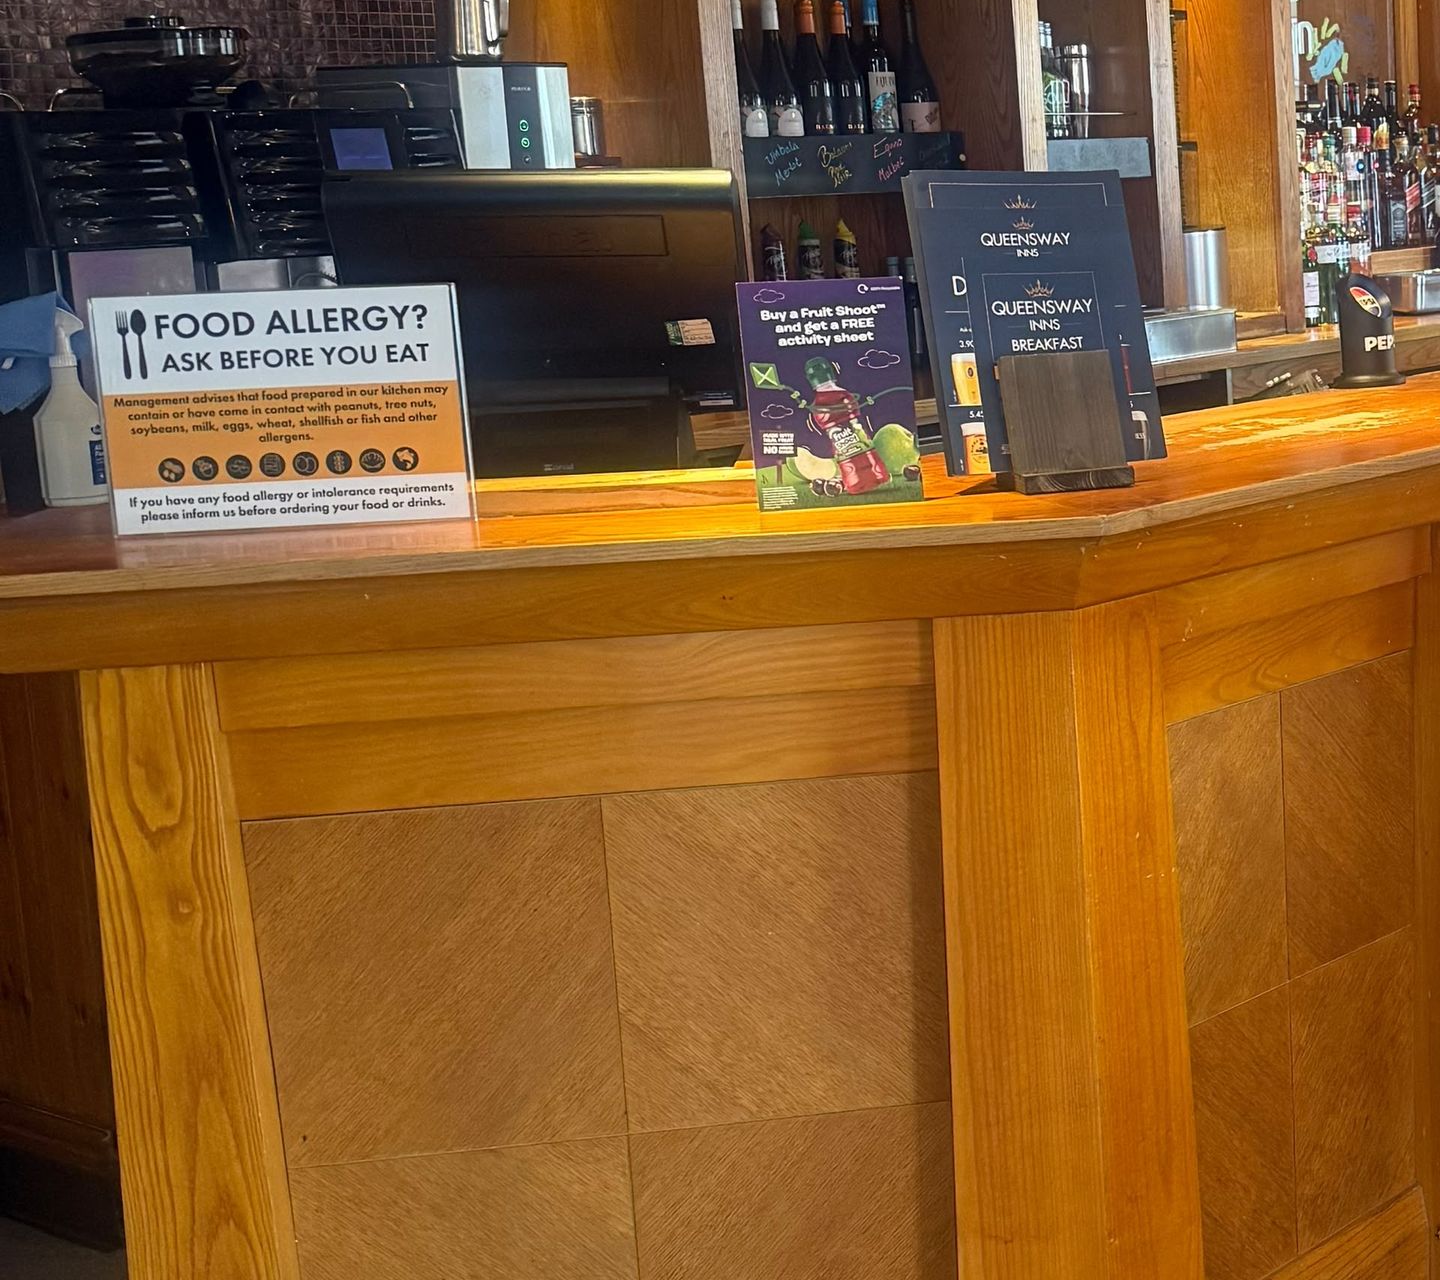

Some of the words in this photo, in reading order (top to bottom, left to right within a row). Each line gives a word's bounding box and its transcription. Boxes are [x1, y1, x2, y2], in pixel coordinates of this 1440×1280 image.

[877, 156, 905, 182] Malbec
[980, 232, 1070, 247] QUEENSWAY
[1016, 249, 1039, 258] INNS
[760, 310, 787, 322] Buy
[789, 310, 799, 319] a
[800, 307, 833, 318] Fruit
[991, 298, 1093, 317] QUEENSWAY
[154, 311, 255, 339] FOOD
[265, 304, 428, 335] ALLERGY?
[775, 322, 801, 333] and
[804, 321, 828, 335] get
[830, 321, 839, 330] a
[841, 317, 875, 329] FREE
[1029, 319, 1061, 332] INNS
[778, 334, 831, 347] activity
[833, 331, 874, 343] sheet
[1011, 336, 1083, 353] BREAKFAST
[1364, 334, 1396, 352] PEP
[162, 352, 213, 373] ASK
[220, 347, 314, 370] BEFORE
[320, 345, 377, 365] YOU
[386, 343, 429, 363] EAT
[114, 397, 189, 408] Management
[193, 393, 235, 404] advises
[237, 392, 259, 401] that
[262, 391, 288, 401] food
[291, 387, 343, 401] prepared
[346, 387, 357, 396] in
[360, 388, 379, 396] our
[381, 385, 421, 395] kitchen
[424, 386, 448, 395] may
[128, 411, 170, 421] contain
[187, 408, 215, 418] have
[219, 408, 248, 417] come
[251, 405, 262, 415] in
[265, 404, 304, 414] contact
[306, 402, 332, 412] with
[334, 403, 382, 413] peanuts,
[385, 401, 407, 409] tree
[410, 399, 436, 408] nuts,
[130, 424, 189, 437] soybeans,
[192, 422, 219, 432] milk,
[223, 421, 253, 433] eggs,
[257, 419, 296, 429] wheat,
[299, 415, 344, 427] shellfish
[346, 416, 358, 424] or
[361, 414, 381, 424] fish
[383, 413, 405, 423] and
[408, 413, 438, 422] other
[258, 432, 314, 444] allergens.
[763, 446, 778, 455] NO
[129, 497, 137, 508] If
[140, 499, 163, 510] you
[166, 496, 194, 506] have
[197, 496, 220, 505] any
[222, 491, 249, 503] food
[252, 490, 293, 502] allergy
[312, 487, 376, 498] intolerance
[379, 483, 454, 498] requirements
[141, 511, 179, 524] please
[182, 508, 220, 519] inform
[223, 509, 236, 517] us
[238, 505, 276, 516] before
[279, 503, 330, 515] ordering
[333, 503, 359, 514] your
[362, 499, 389, 510] food
[392, 500, 404, 508] or
[407, 497, 446, 508] drinks.
